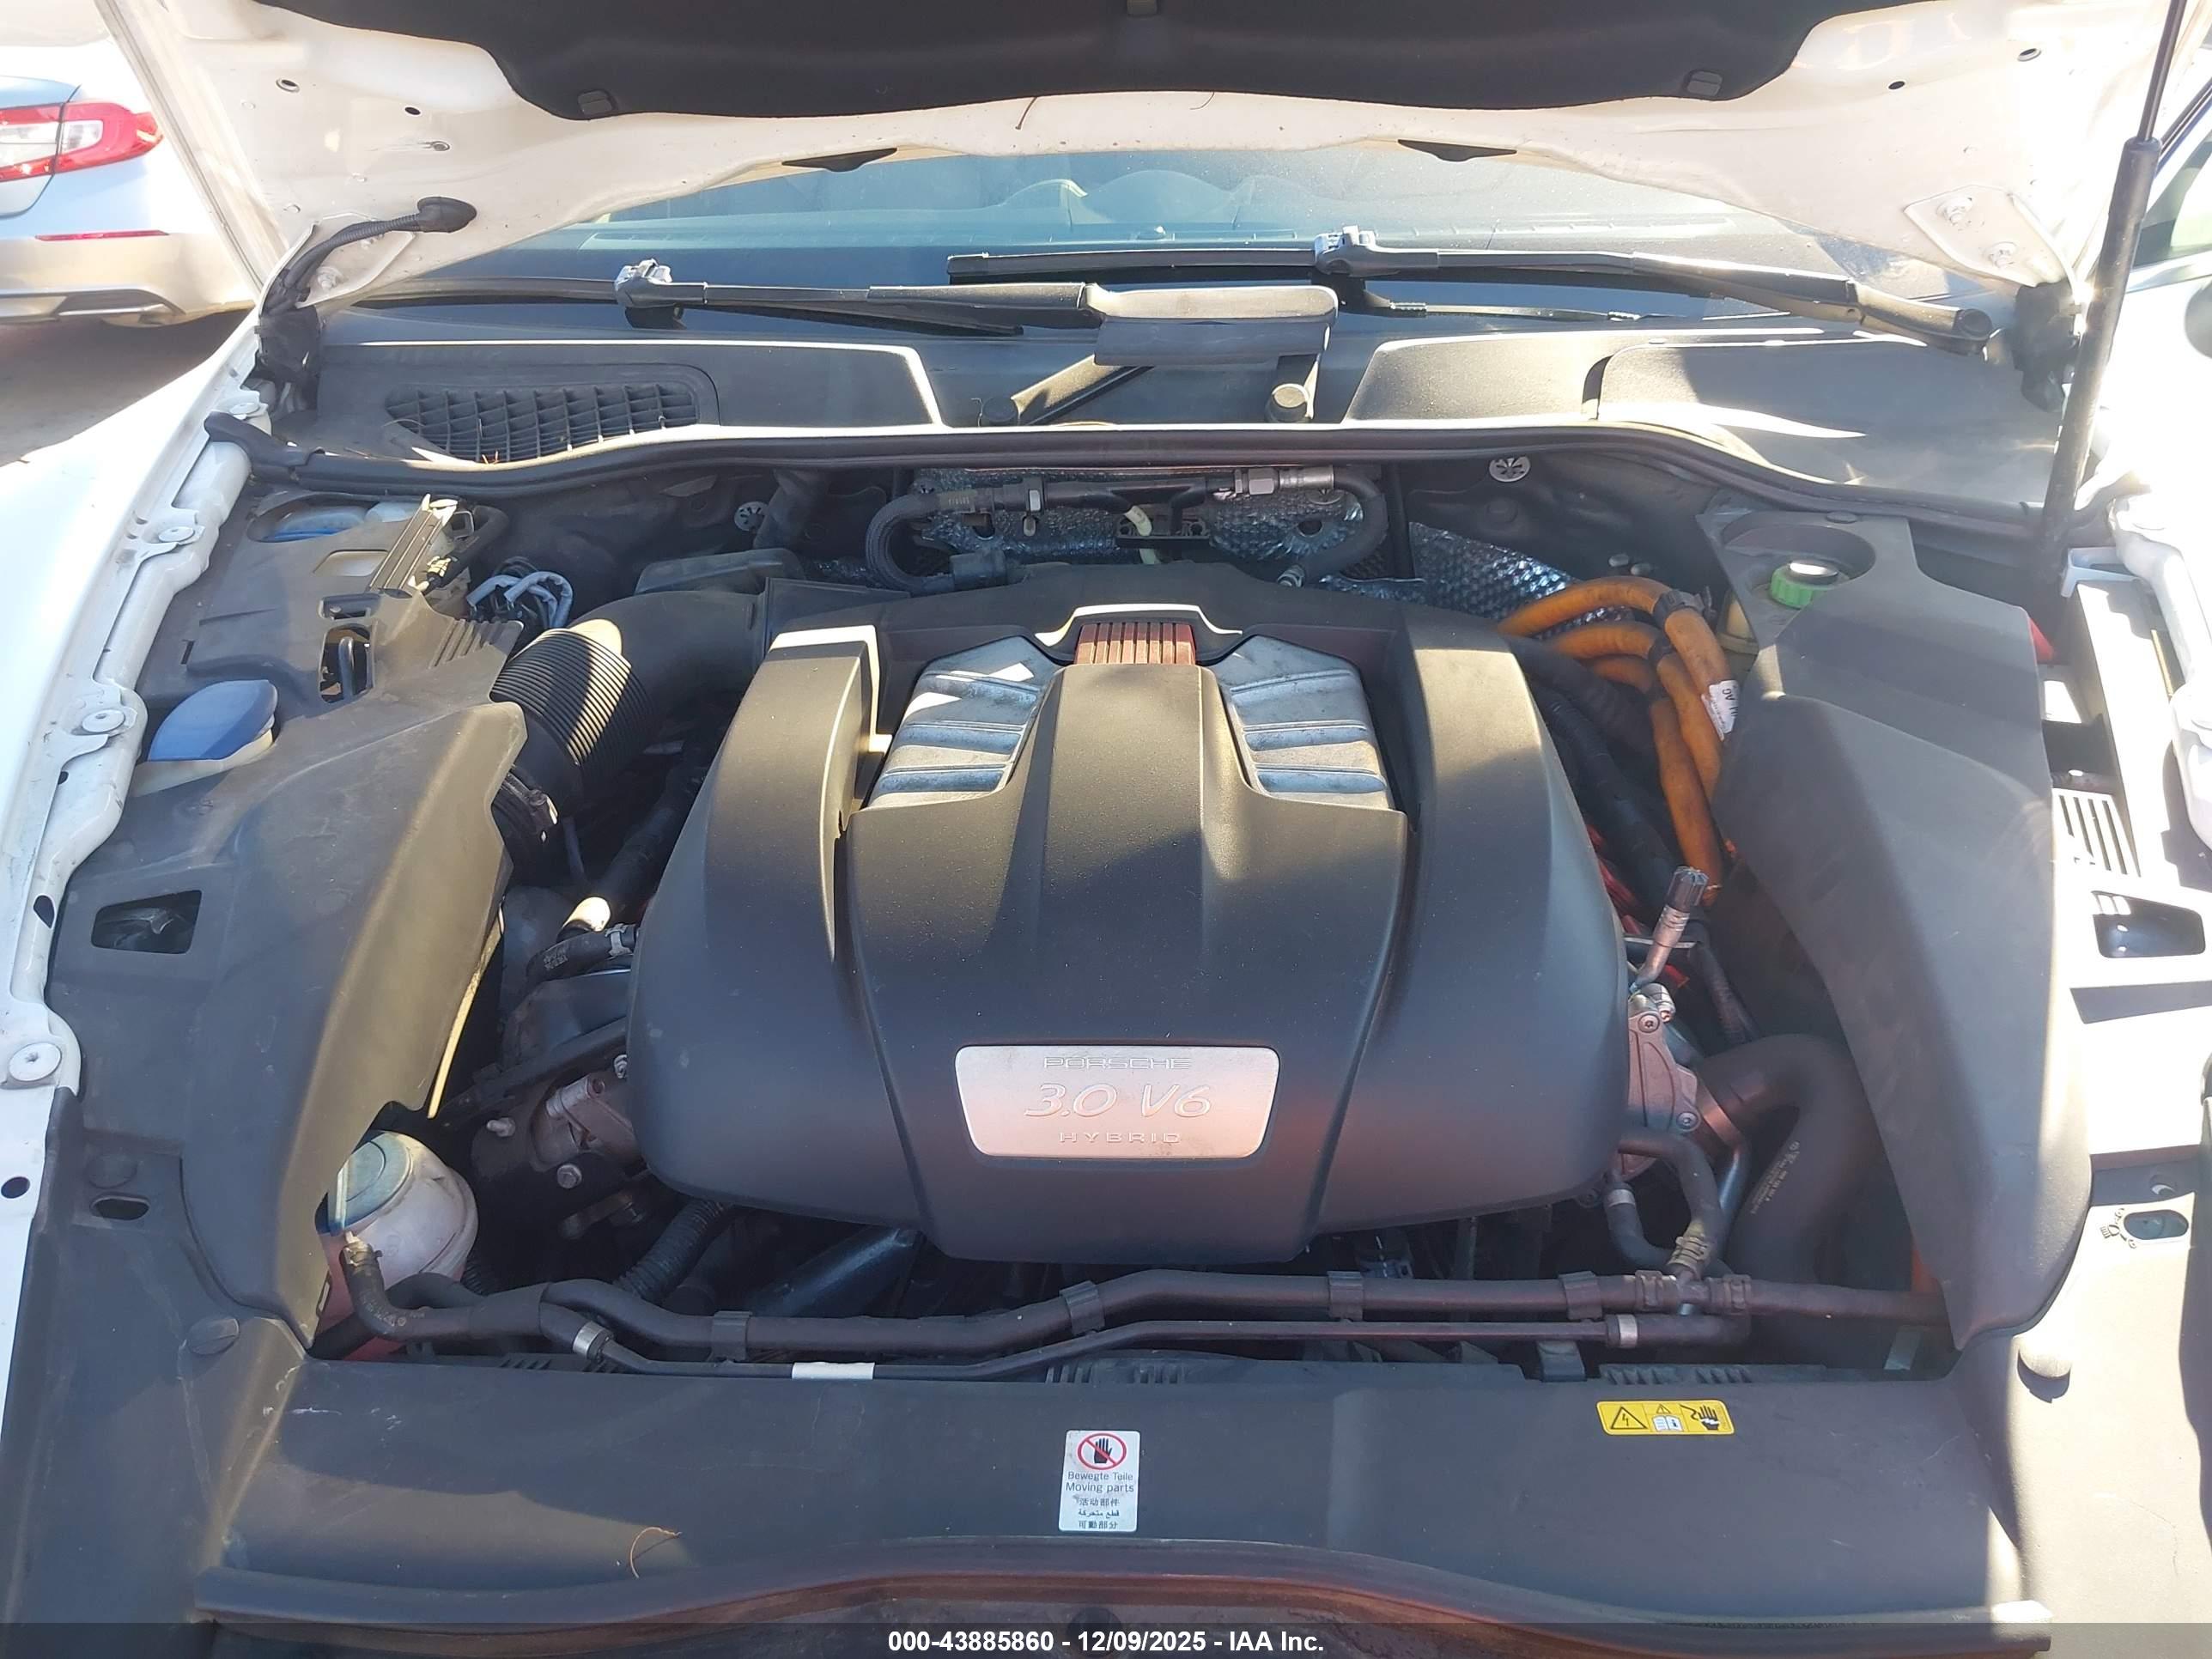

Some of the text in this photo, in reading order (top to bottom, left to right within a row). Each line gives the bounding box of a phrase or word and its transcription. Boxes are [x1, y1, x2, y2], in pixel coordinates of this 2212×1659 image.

[1043, 1057, 1192, 1069] PORSCHE
[1024, 1083, 1212, 1118] 3.0 V6
[1059, 1132, 1183, 1144] HYBRID
[1068, 1471, 1133, 1481] Bewegte Teile
[1066, 1482, 1134, 1493] Moving parts
